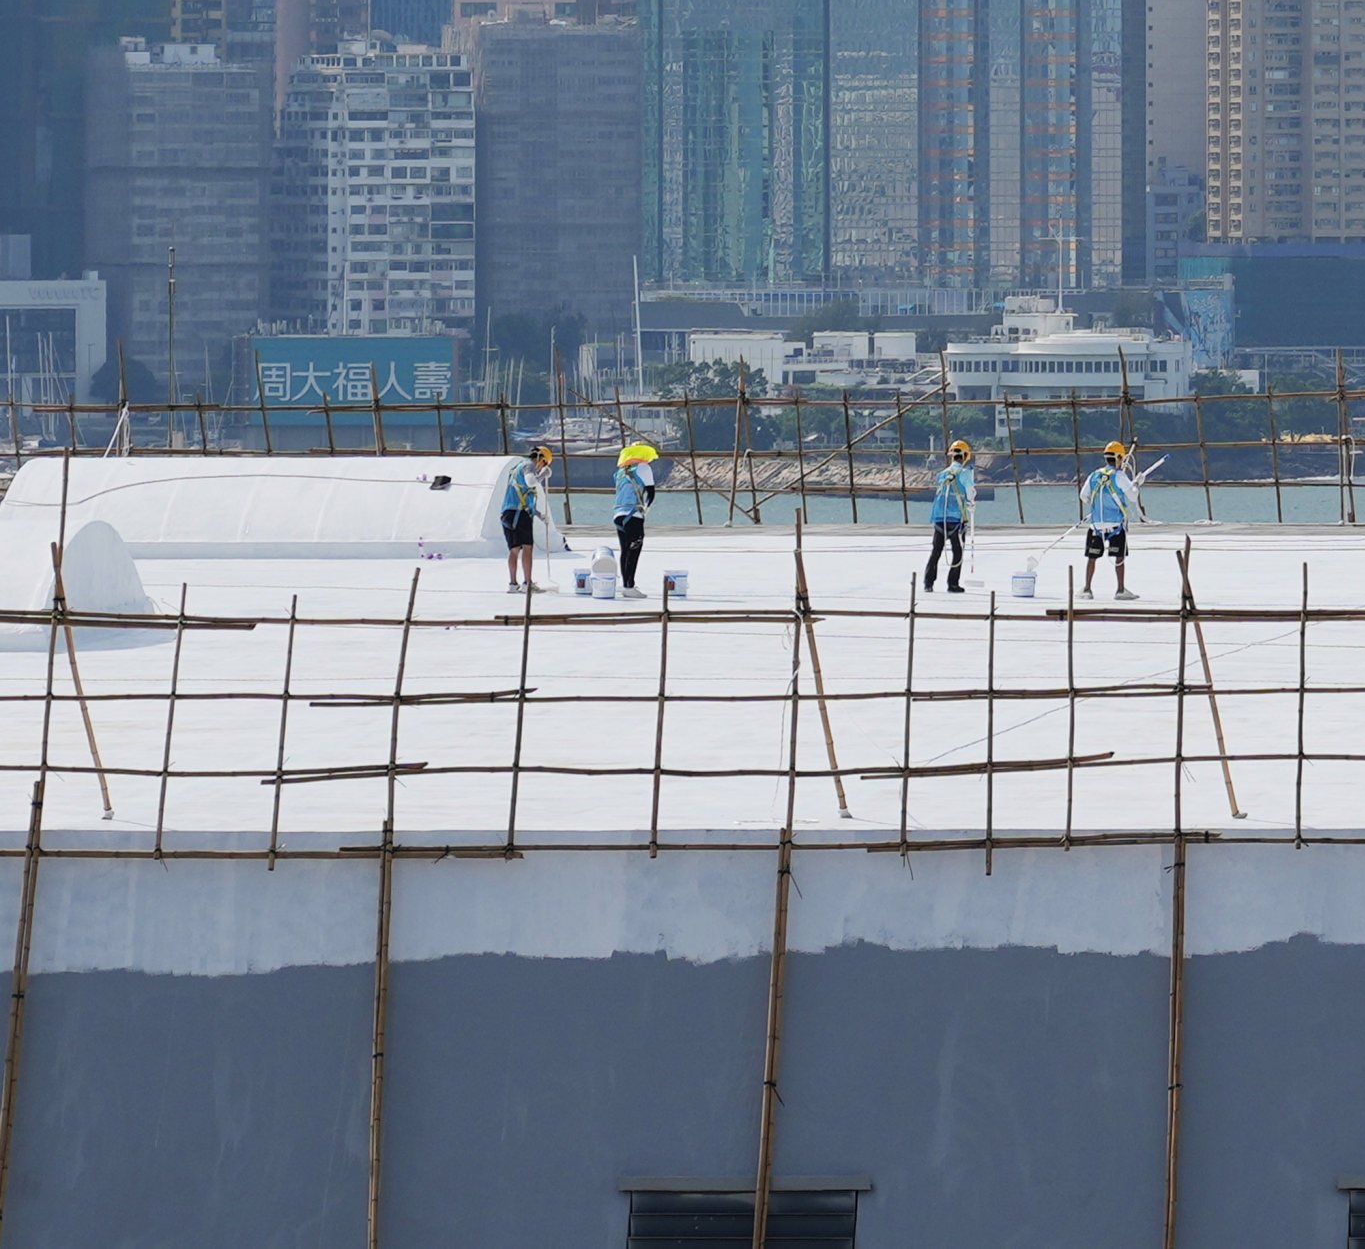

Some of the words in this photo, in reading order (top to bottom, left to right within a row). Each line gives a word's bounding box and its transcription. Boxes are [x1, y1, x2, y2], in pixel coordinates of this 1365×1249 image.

[253, 362, 451, 401] 周大福人壽
